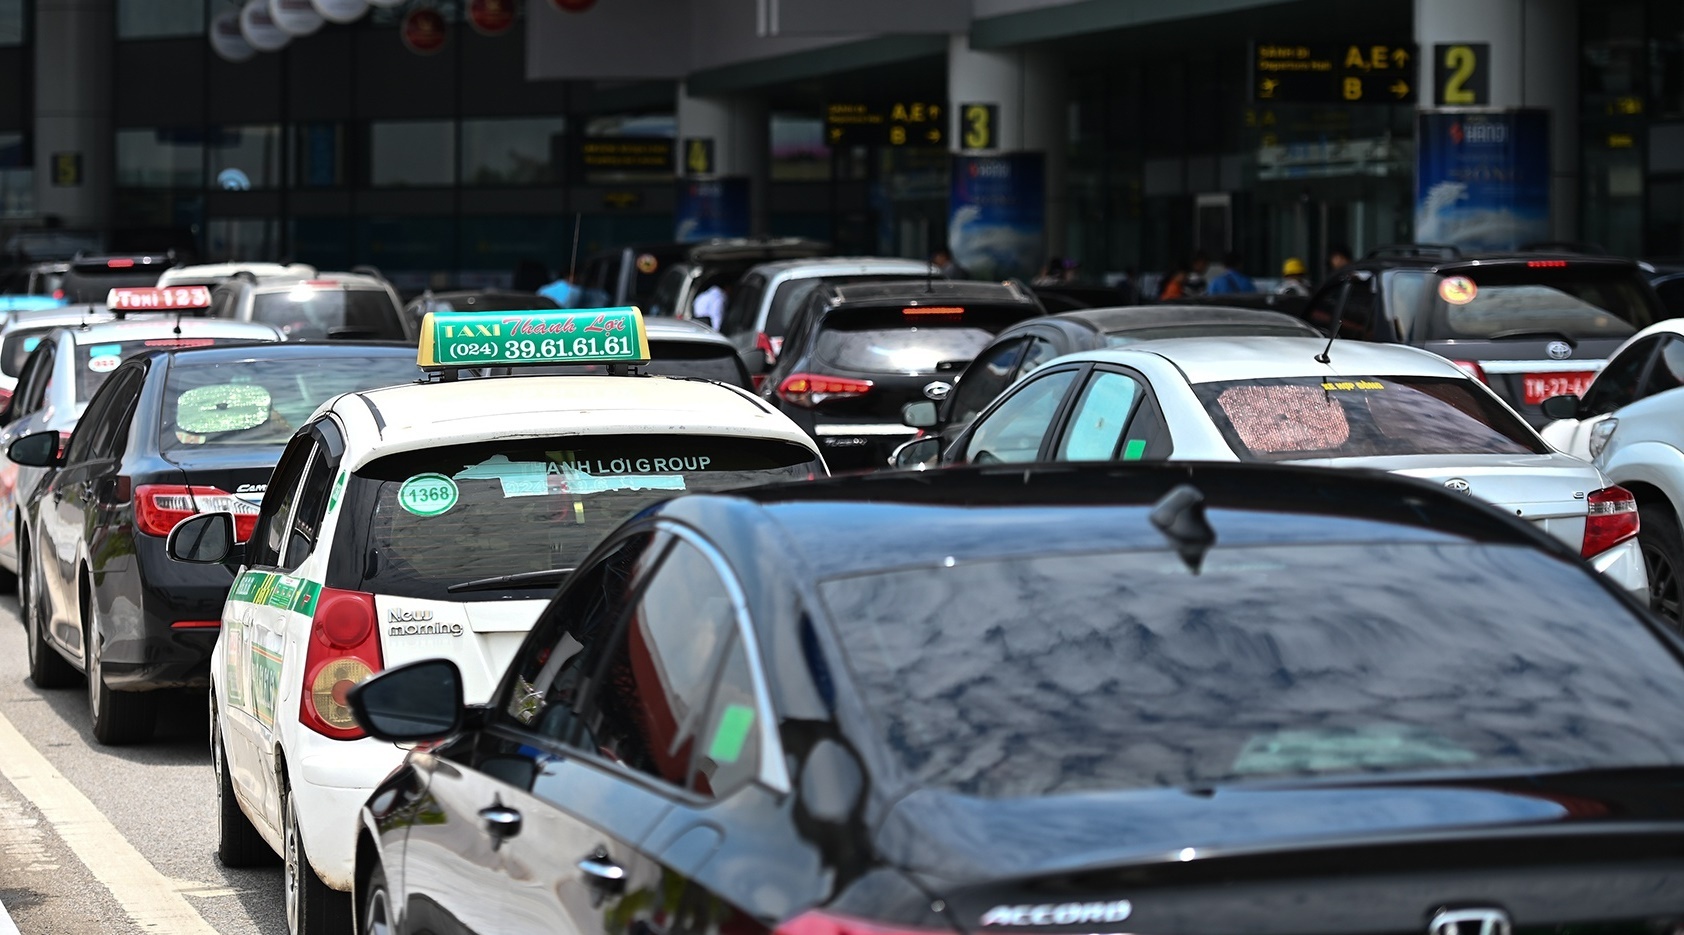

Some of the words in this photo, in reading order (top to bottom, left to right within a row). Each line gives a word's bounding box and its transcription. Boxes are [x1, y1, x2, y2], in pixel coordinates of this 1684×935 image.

[1345, 45, 1389, 71] A,E
[1444, 45, 1476, 104] 2
[1343, 77, 1363, 99] B
[890, 126, 906, 145] B
[965, 105, 989, 148] 3
[688, 142, 707, 172] 4
[117, 290, 158, 307] Taxi
[162, 288, 207, 307] 123
[441, 323, 501, 338] TAXI
[502, 314, 576, 336] Thành
[584, 314, 626, 337] Lợi
[450, 341, 498, 359] (024)
[505, 336, 631, 359] 39.61.61.61
[636, 456, 710, 472] GROUP
[409, 486, 449, 503] 1368
[388, 607, 433, 623] New
[388, 623, 463, 637] morning
[980, 899, 1132, 926] ACCORD
